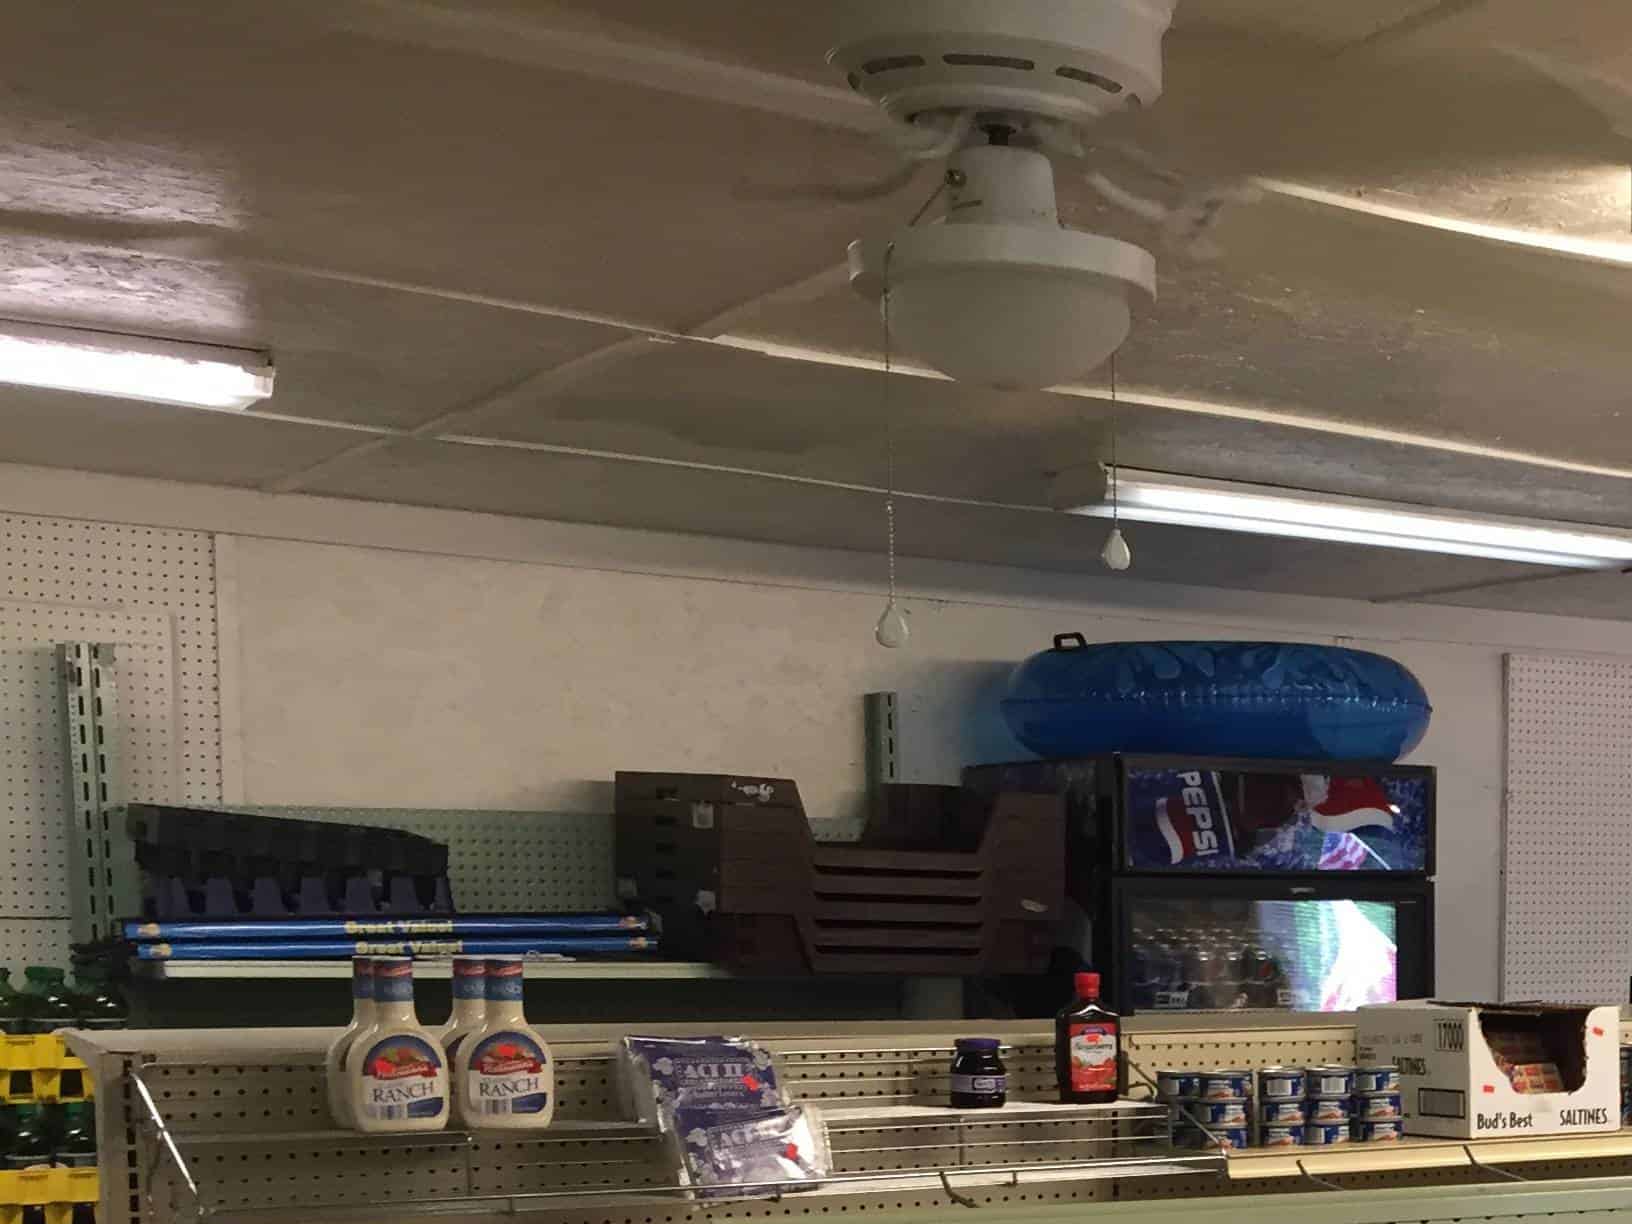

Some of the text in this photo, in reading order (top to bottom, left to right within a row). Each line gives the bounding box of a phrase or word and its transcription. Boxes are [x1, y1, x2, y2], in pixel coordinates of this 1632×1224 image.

[1176, 771, 1219, 856] PEPSI
[373, 1081, 434, 1103] RANCH
[479, 1077, 539, 1098] RANCH
[1477, 1113, 1534, 1130] Bud's Best
[1560, 1108, 1609, 1126] SALTINES
